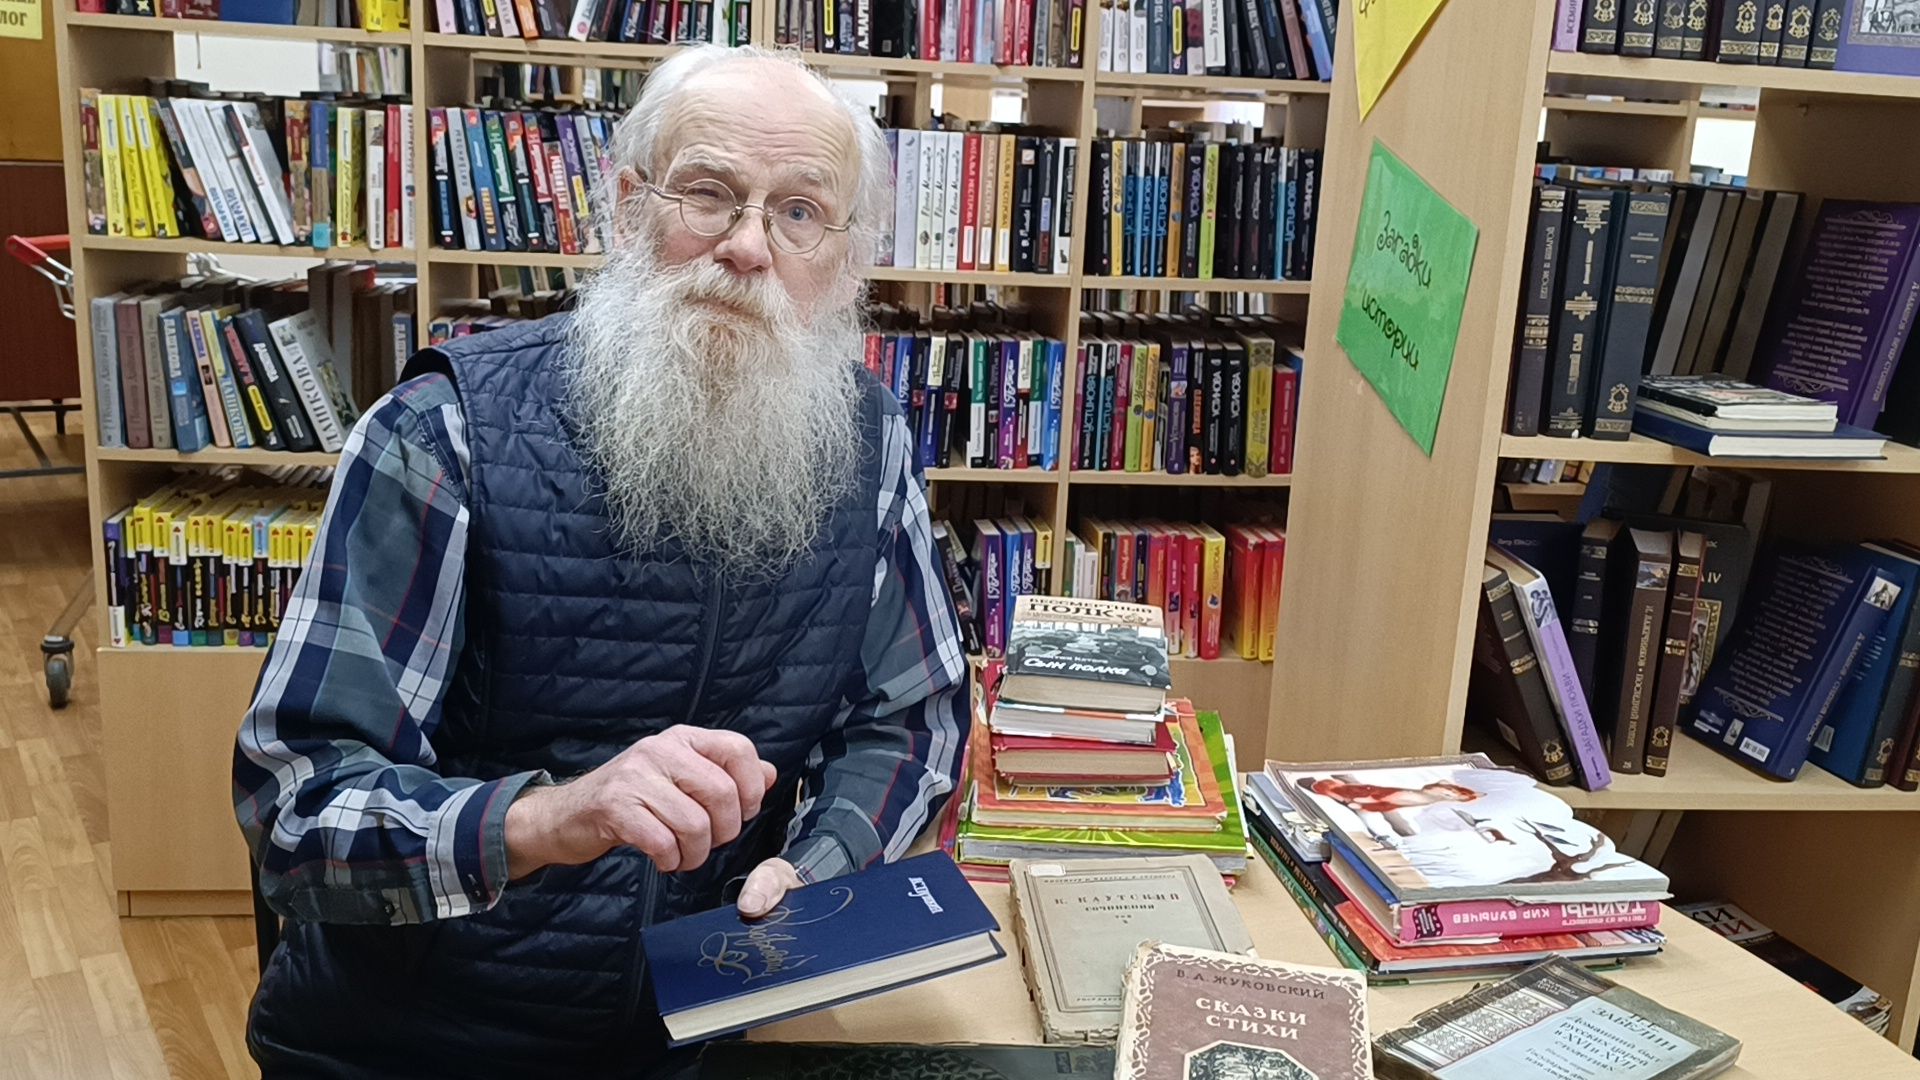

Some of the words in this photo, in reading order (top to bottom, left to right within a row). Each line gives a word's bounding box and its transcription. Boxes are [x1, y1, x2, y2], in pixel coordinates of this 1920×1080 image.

[966, 181, 975, 224] НЕСТЕРОВА
[1157, 176, 1168, 237] УСТИНОВА
[1285, 181, 1296, 242] УСТИНОВА
[1377, 210, 1431, 288] Загадки
[1361, 288, 1419, 370] истории
[221, 377, 247, 443] ДАШКОВА
[291, 352, 343, 447] ДАШКОВА
[1083, 375, 1095, 433] УСТИНОВА
[1102, 375, 1114, 433] УСТИНОВА
[1708, 572, 1722, 583] IV
[1029, 598, 1152, 614] БЕССМЕРТНЫЙ
[1029, 603, 1114, 617] ПОЛК
[1024, 657, 1066, 670] Сын
[1069, 663, 1129, 676] полка
[1562, 671, 1580, 705] ЛЮБВИ
[1629, 669, 1645, 720] ПОСЛЕДНИЙ
[1571, 708, 1592, 752] ЗАГАДКИ
[1078, 893, 1180, 903] КАУТСКИЙ
[1085, 904, 1155, 912] СОЧИНЕНИЯ
[1523, 908, 1550, 919] КИР
[1213, 975, 1326, 999] ЖУКОВСКИЙ
[1195, 997, 1308, 1026] СКАЗКИ
[1206, 1014, 1299, 1040] СТИХИ
[1591, 1007, 1678, 1052] ЗАБЕЛИН
[1558, 1021, 1610, 1048] русских
[1609, 1045, 1651, 1068] царей
[1562, 1032, 1593, 1055] XVI
[1599, 1051, 1639, 1071] XVII
[1566, 1015, 1637, 1051] Домашний
[1554, 1040, 1617, 1073] столетиях
